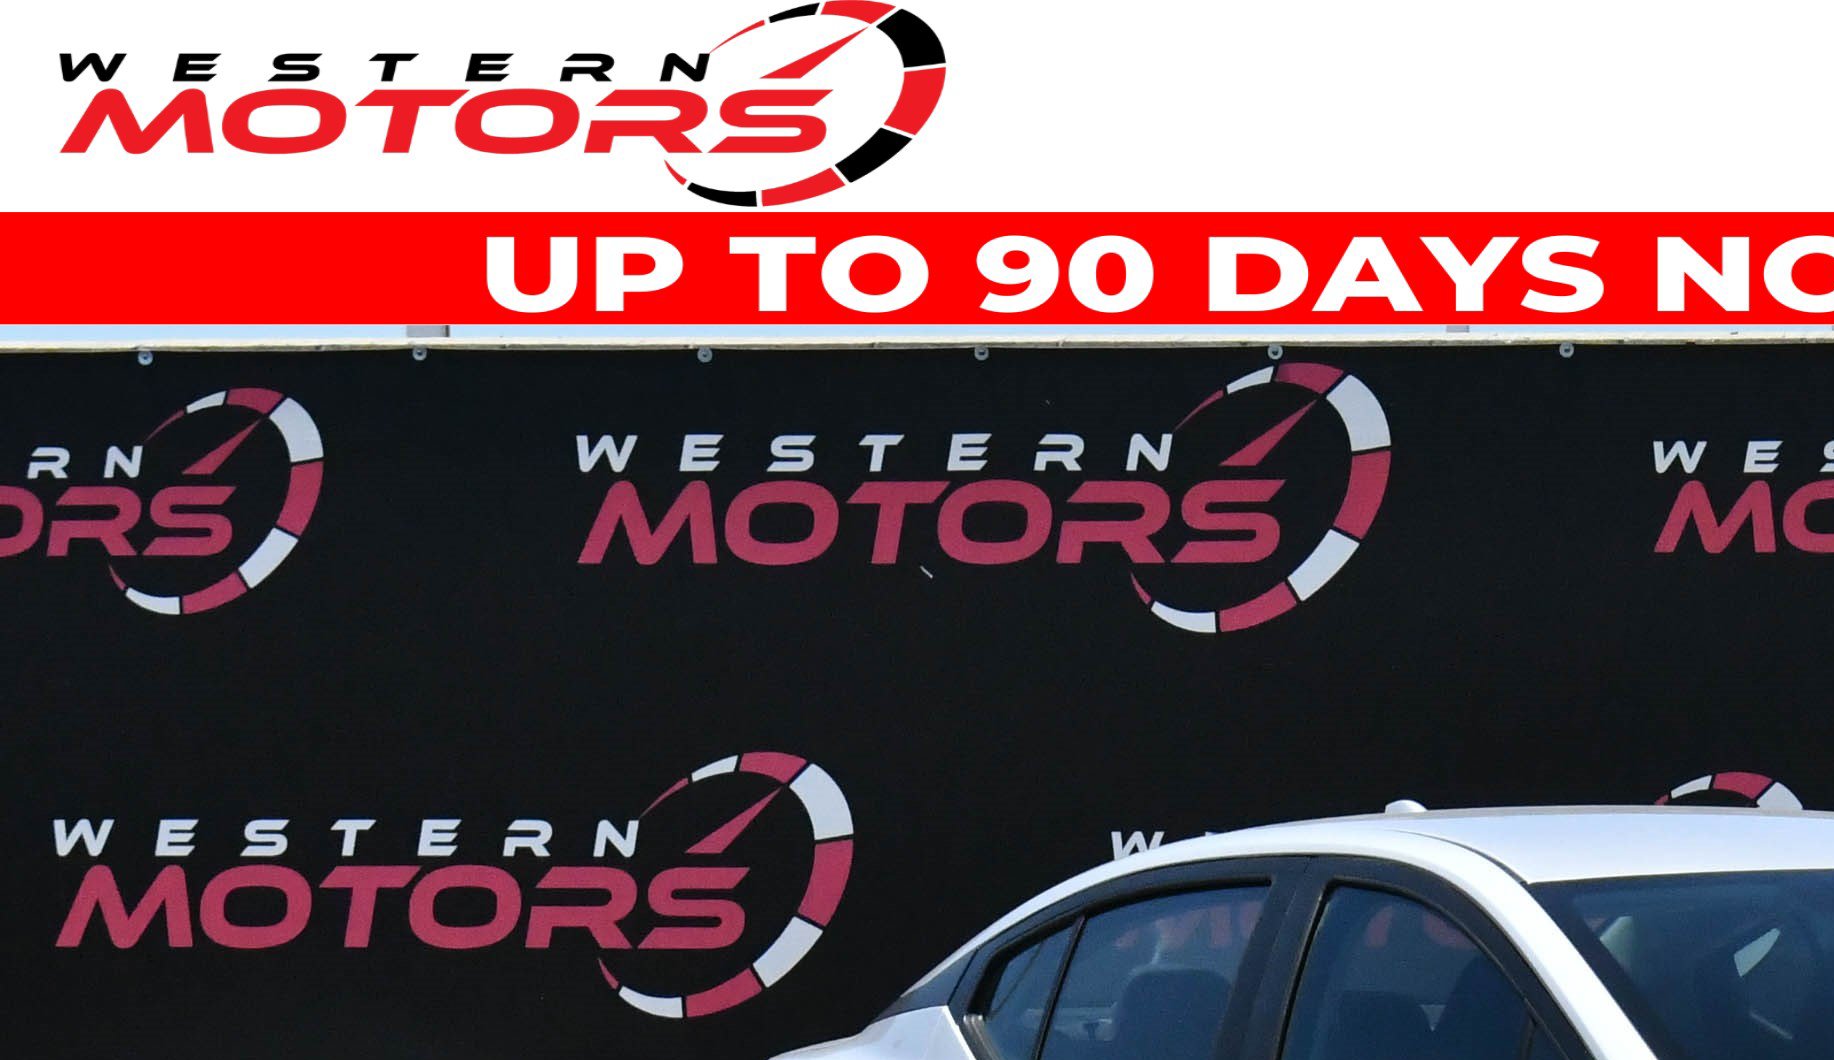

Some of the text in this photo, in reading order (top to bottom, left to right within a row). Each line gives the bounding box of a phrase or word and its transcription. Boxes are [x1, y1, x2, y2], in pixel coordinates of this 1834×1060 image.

[576, 434, 1173, 472] WESTERN
[578, 480, 1285, 565] MOTORS
[54, 819, 640, 857] WESTERN
[55, 864, 749, 950] MOTORS
